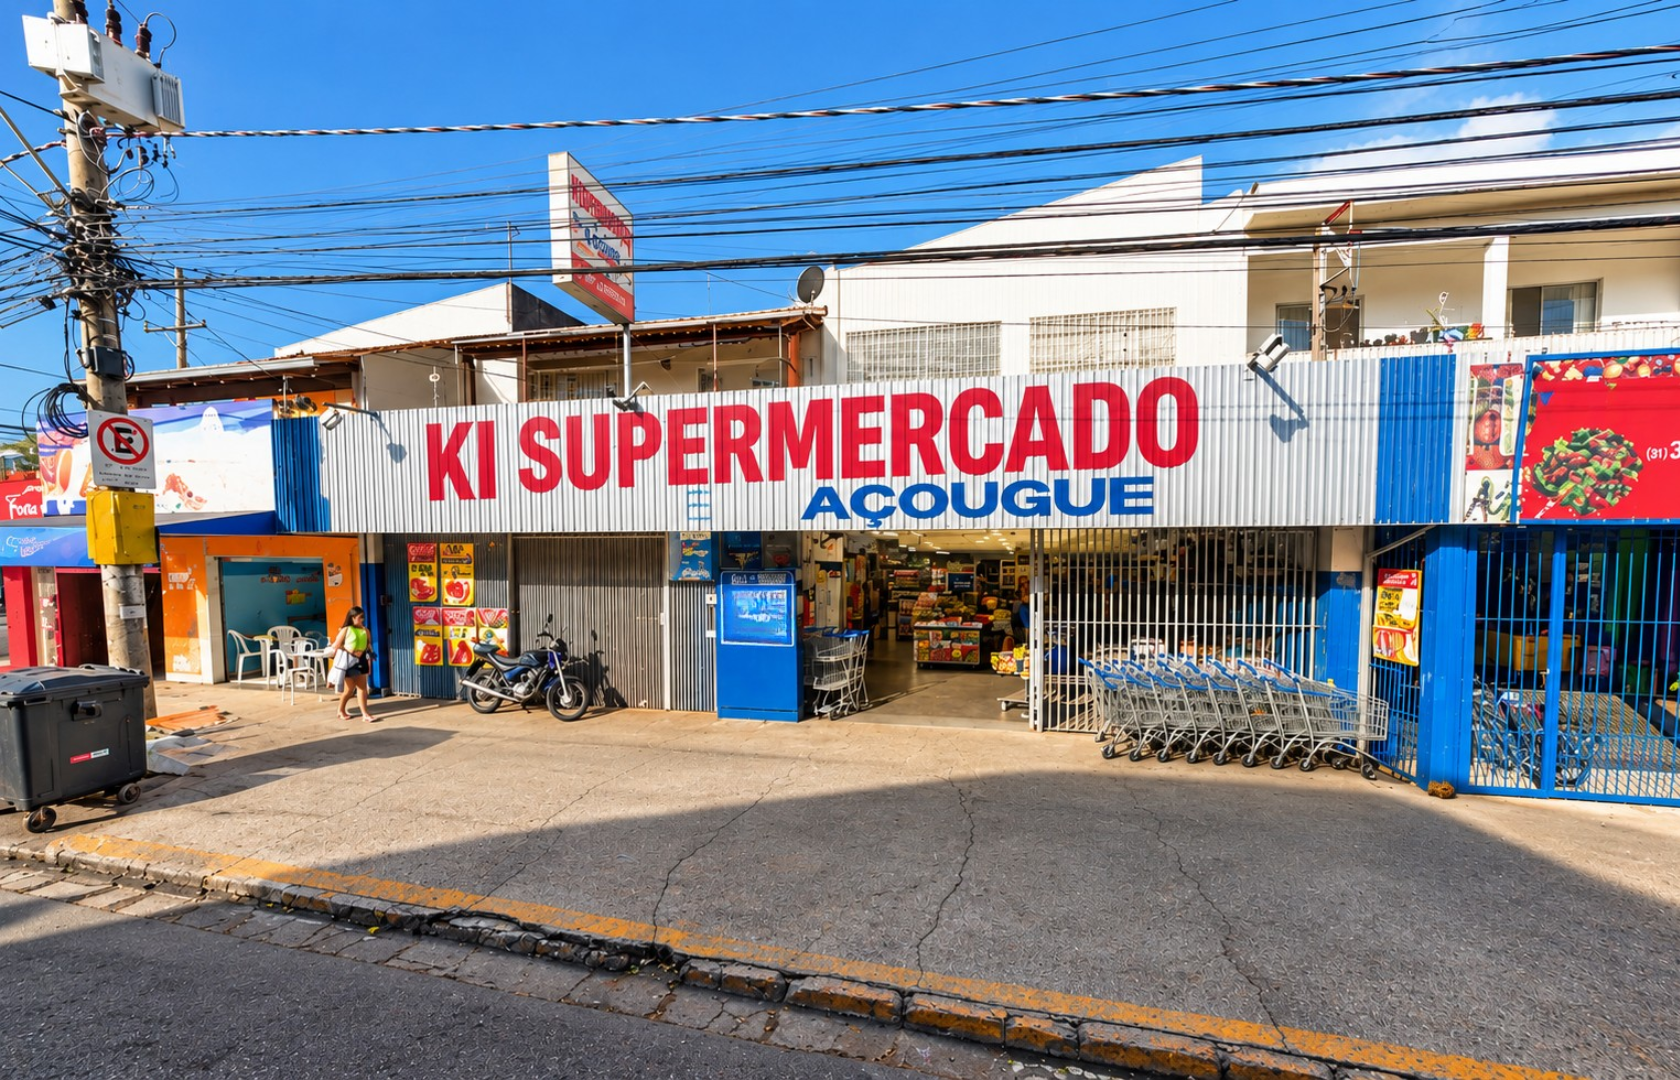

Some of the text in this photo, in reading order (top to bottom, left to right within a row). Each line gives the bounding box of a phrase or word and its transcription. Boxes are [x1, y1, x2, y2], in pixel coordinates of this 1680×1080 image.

[427, 376, 1199, 501] KI SUPERMERCADO
[1646, 446, 1668, 462] (31)
[801, 475, 1155, 530] AÇOUGUE
